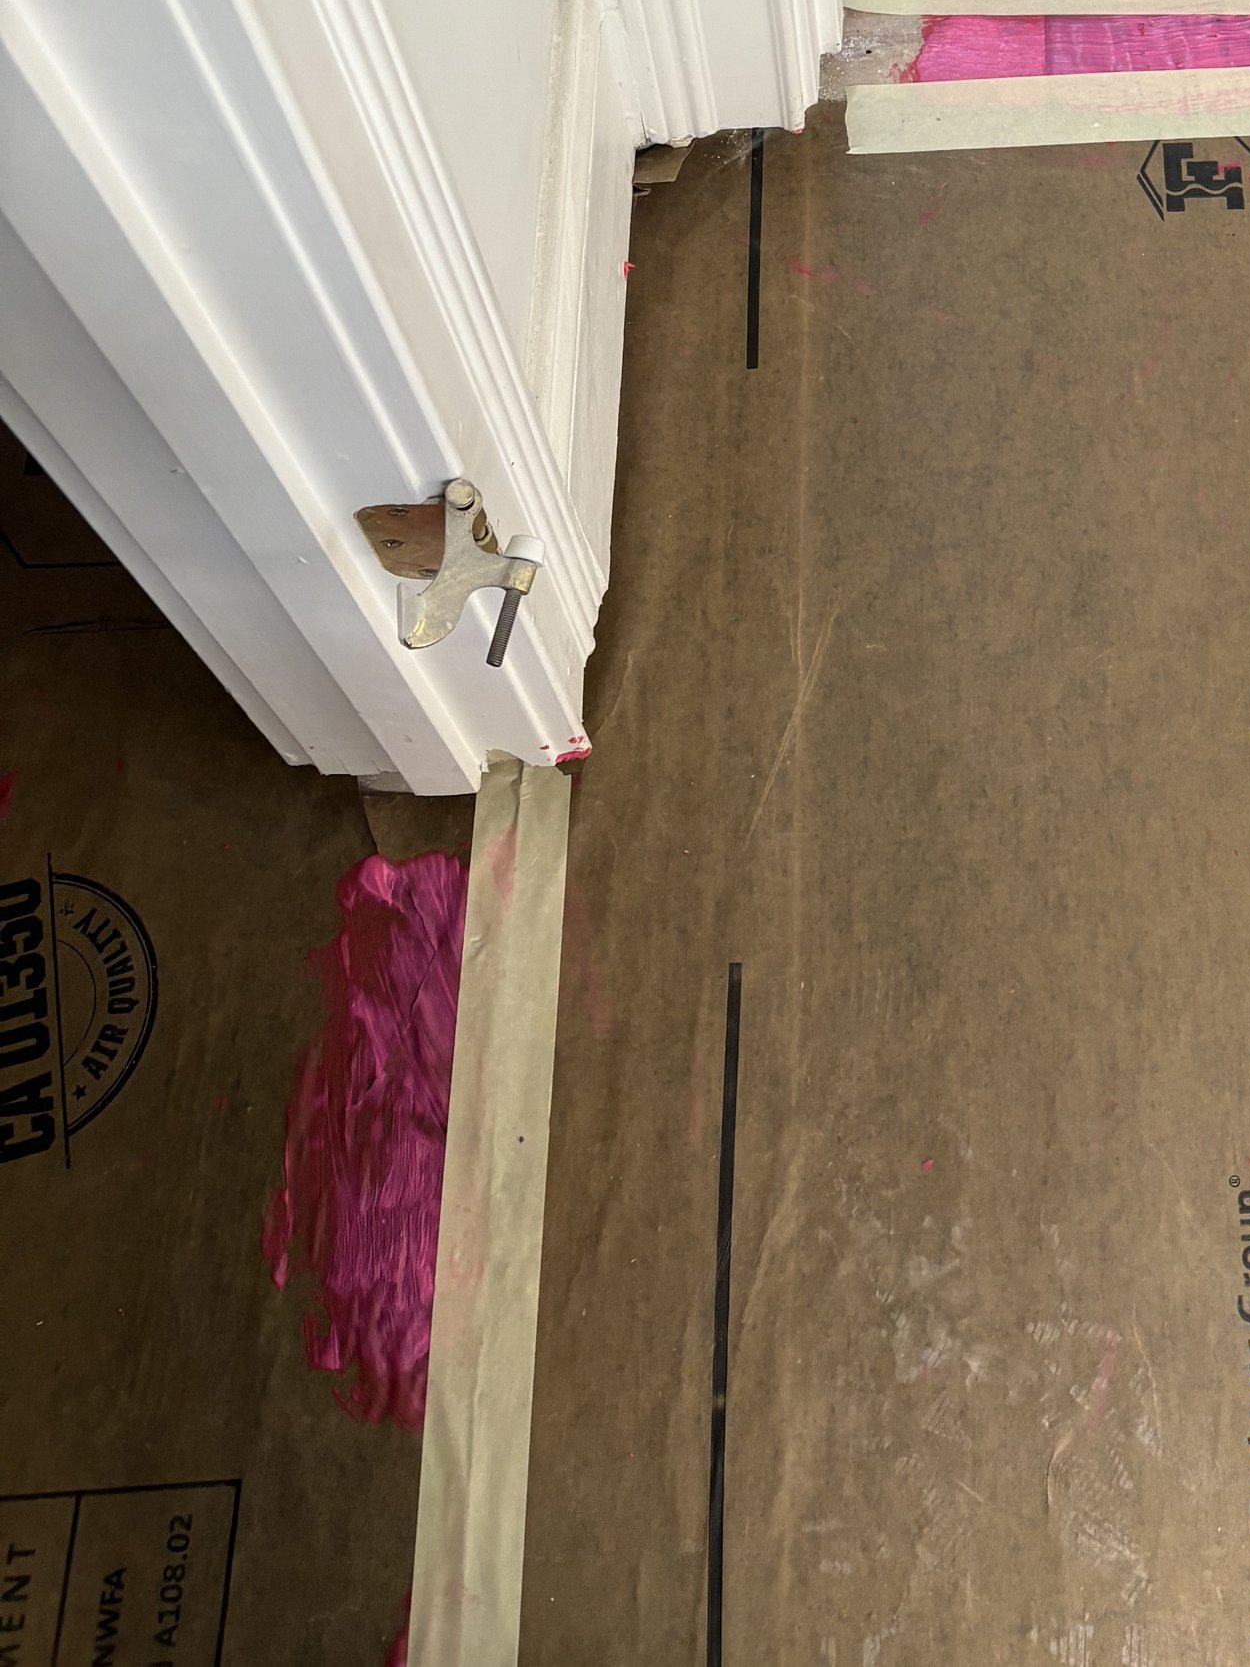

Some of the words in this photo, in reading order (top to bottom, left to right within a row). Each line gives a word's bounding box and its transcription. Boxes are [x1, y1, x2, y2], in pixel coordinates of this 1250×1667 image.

[73, 908, 140, 1015] QUALITY
[81, 1023, 129, 1081] AIR
[154, 1513, 193, 1647] A108.02
